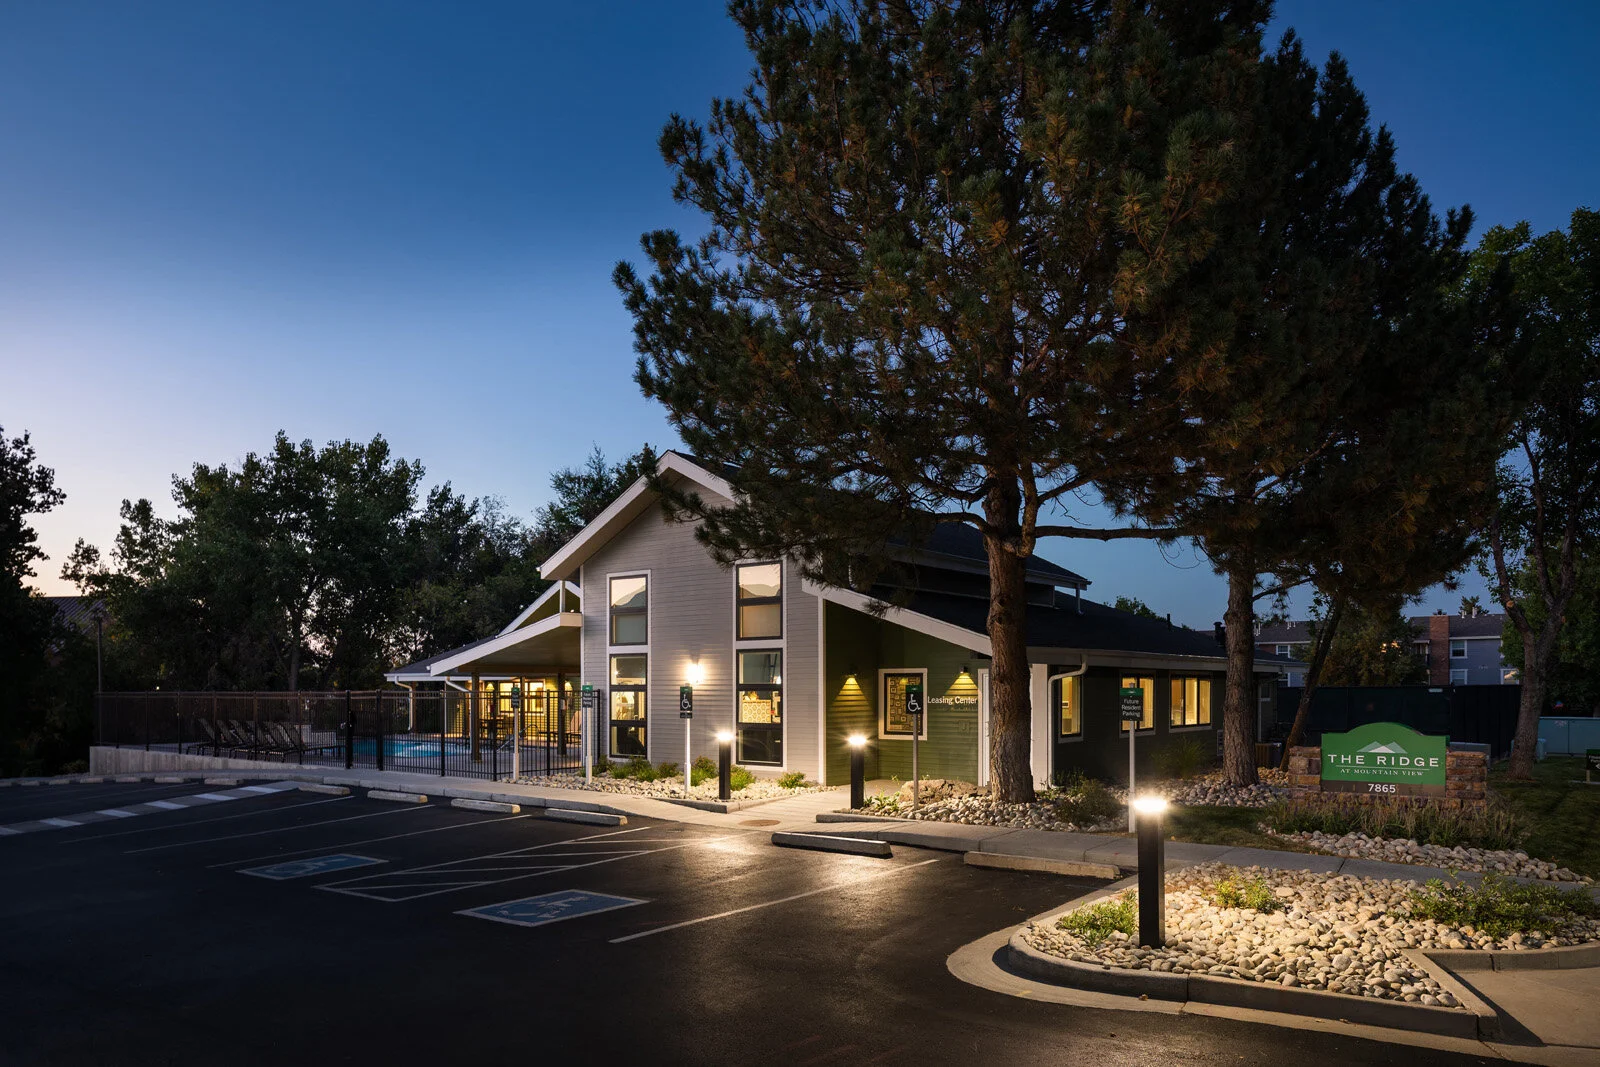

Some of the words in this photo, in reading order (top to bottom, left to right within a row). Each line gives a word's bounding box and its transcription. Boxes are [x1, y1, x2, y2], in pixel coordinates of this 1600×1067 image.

[927, 696, 953, 705] Leasing
[954, 696, 978, 704] Center
[1328, 754, 1365, 765] THE
[1377, 756, 1439, 767] RIDGE
[1367, 783, 1396, 793] 7865
